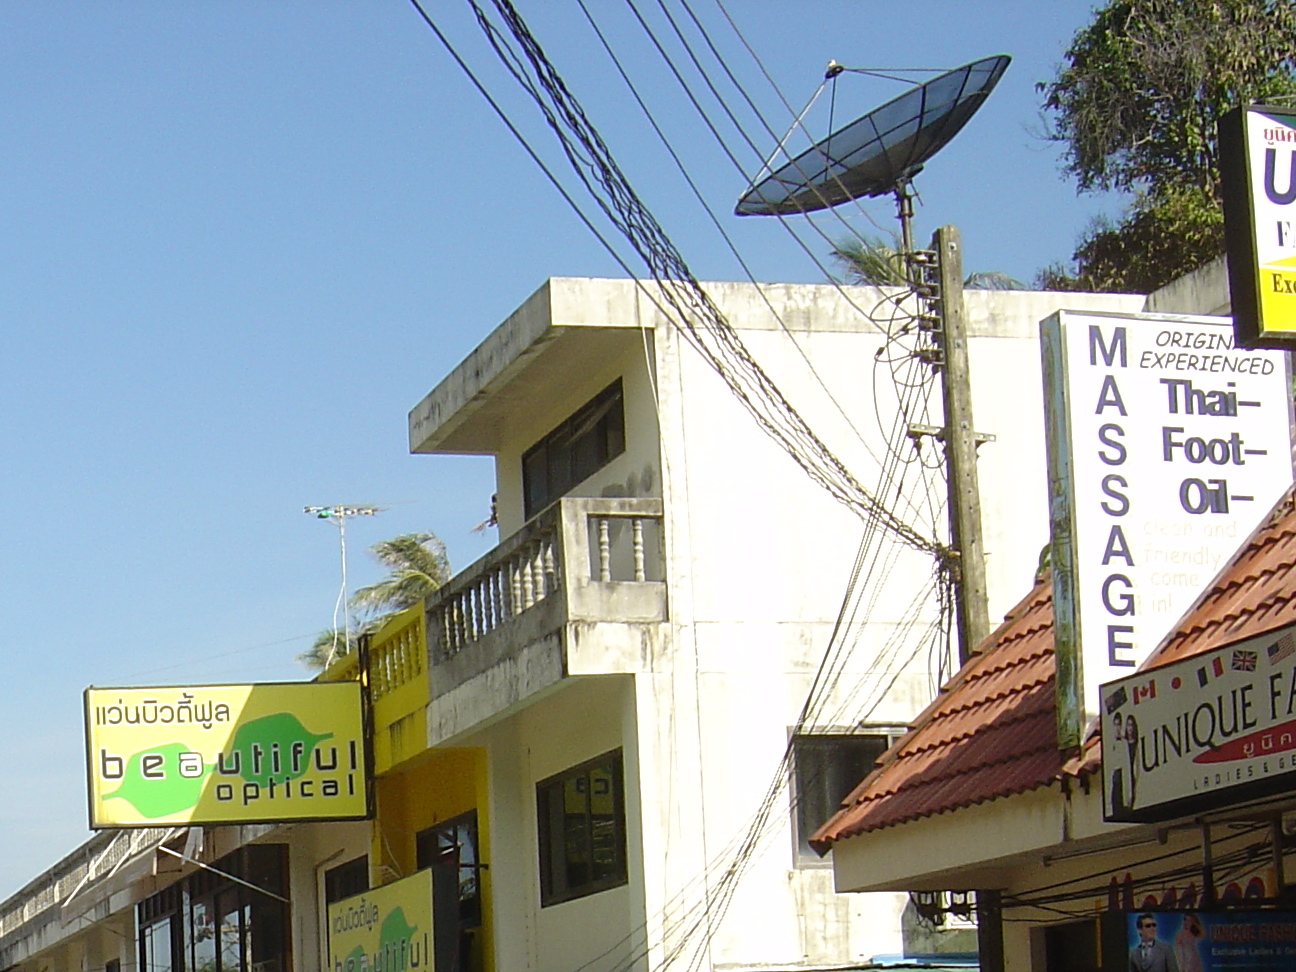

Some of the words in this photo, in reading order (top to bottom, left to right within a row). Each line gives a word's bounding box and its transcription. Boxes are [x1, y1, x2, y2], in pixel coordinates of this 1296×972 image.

[1156, 330, 1253, 351] ORIGIN
[1139, 350, 1275, 376] EXPERIENCED
[1088, 325, 1137, 668] MASSAGE
[96, 692, 230, 729] แว่นบิวตี้ฟูล
[1140, 684, 1258, 772] UNIQUE
[101, 740, 357, 779] beautiful
[216, 774, 354, 805] optical
[1194, 766, 1253, 790] LADIES
[1210, 924, 1256, 942] UNIQUE
